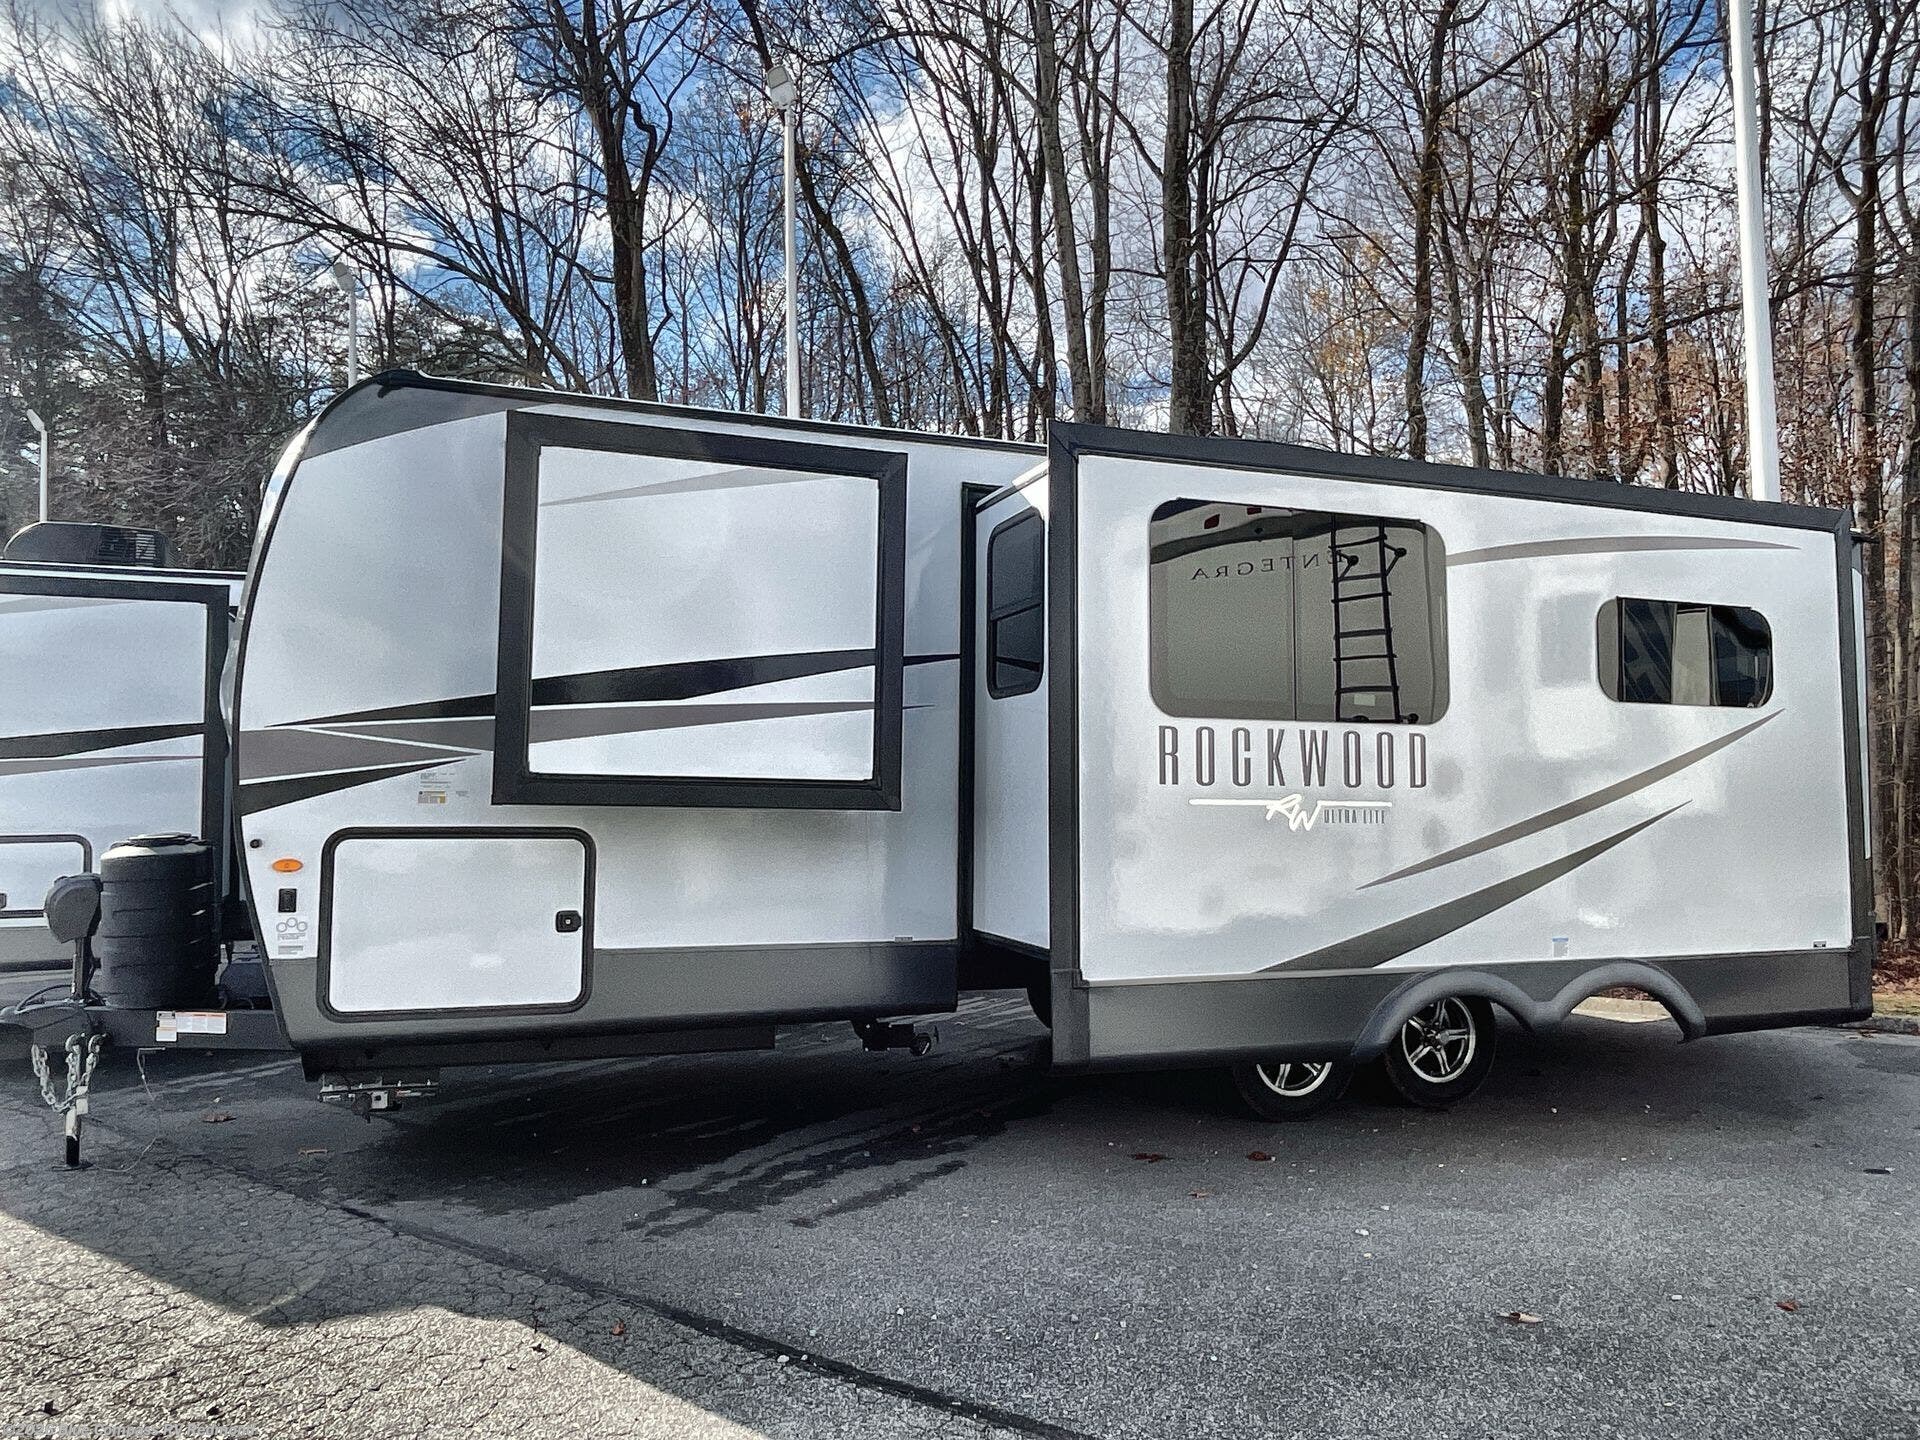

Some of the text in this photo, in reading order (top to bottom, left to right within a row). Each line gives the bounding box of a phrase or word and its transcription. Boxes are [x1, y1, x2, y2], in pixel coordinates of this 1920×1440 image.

[1158, 725, 1428, 790] ROCKWOOD
[1323, 808, 1386, 825] ULTRA LITE
